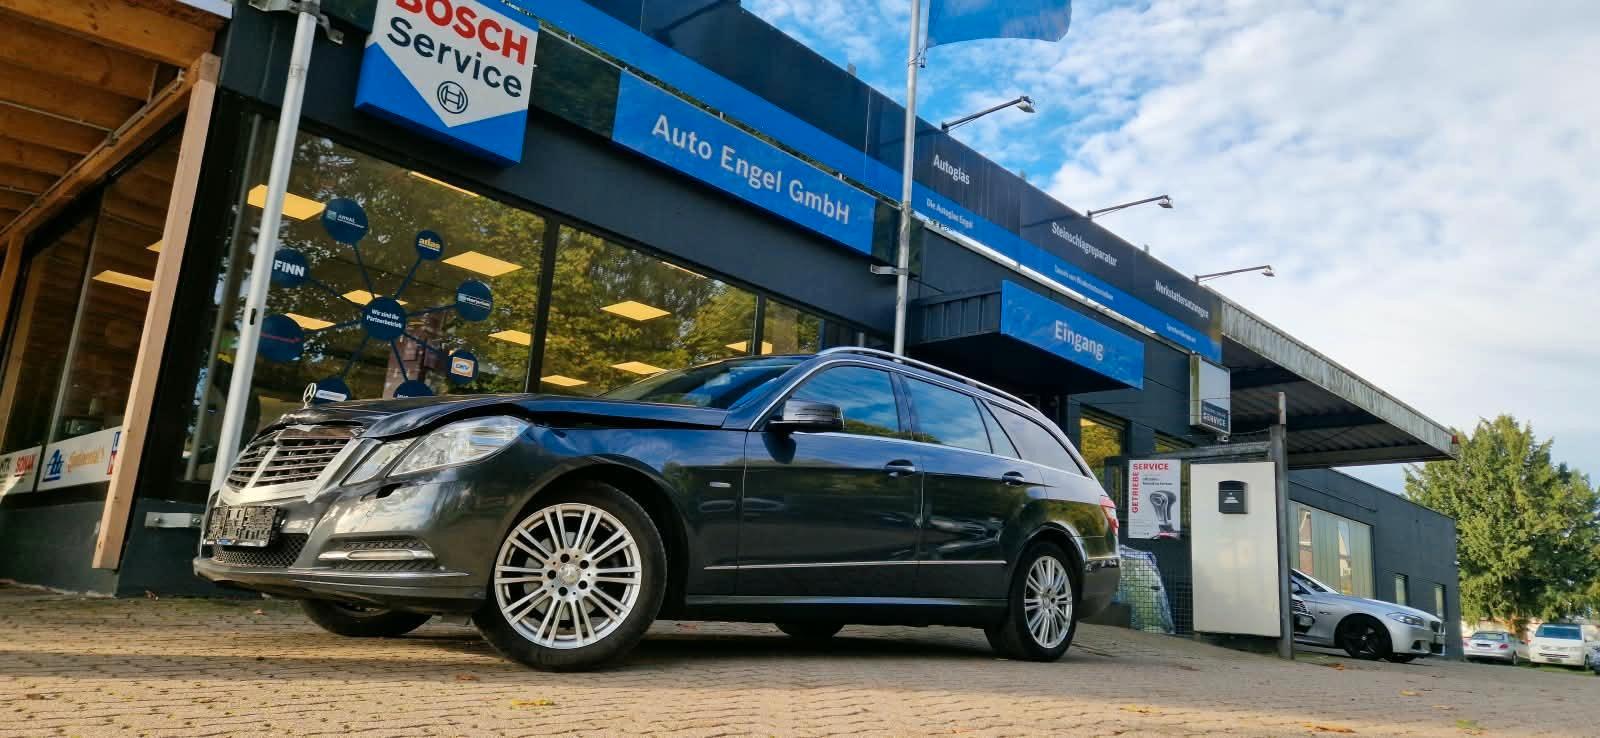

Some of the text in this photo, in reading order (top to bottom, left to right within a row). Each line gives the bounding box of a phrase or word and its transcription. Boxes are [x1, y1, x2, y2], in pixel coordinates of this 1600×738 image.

[387, 17, 522, 97] Service
[652, 114, 849, 225] Auto Engel GmbH
[933, 154, 970, 185] Autoglas
[1052, 221, 1117, 267] Steinschlagreparatur
[273, 259, 305, 277] FINN
[366, 314, 402, 329] Partnerbetrieb
[1055, 319, 1104, 361] Eingang
[1132, 462, 1169, 471] SERVICE
[1131, 471, 1140, 514] GETRIEBE
